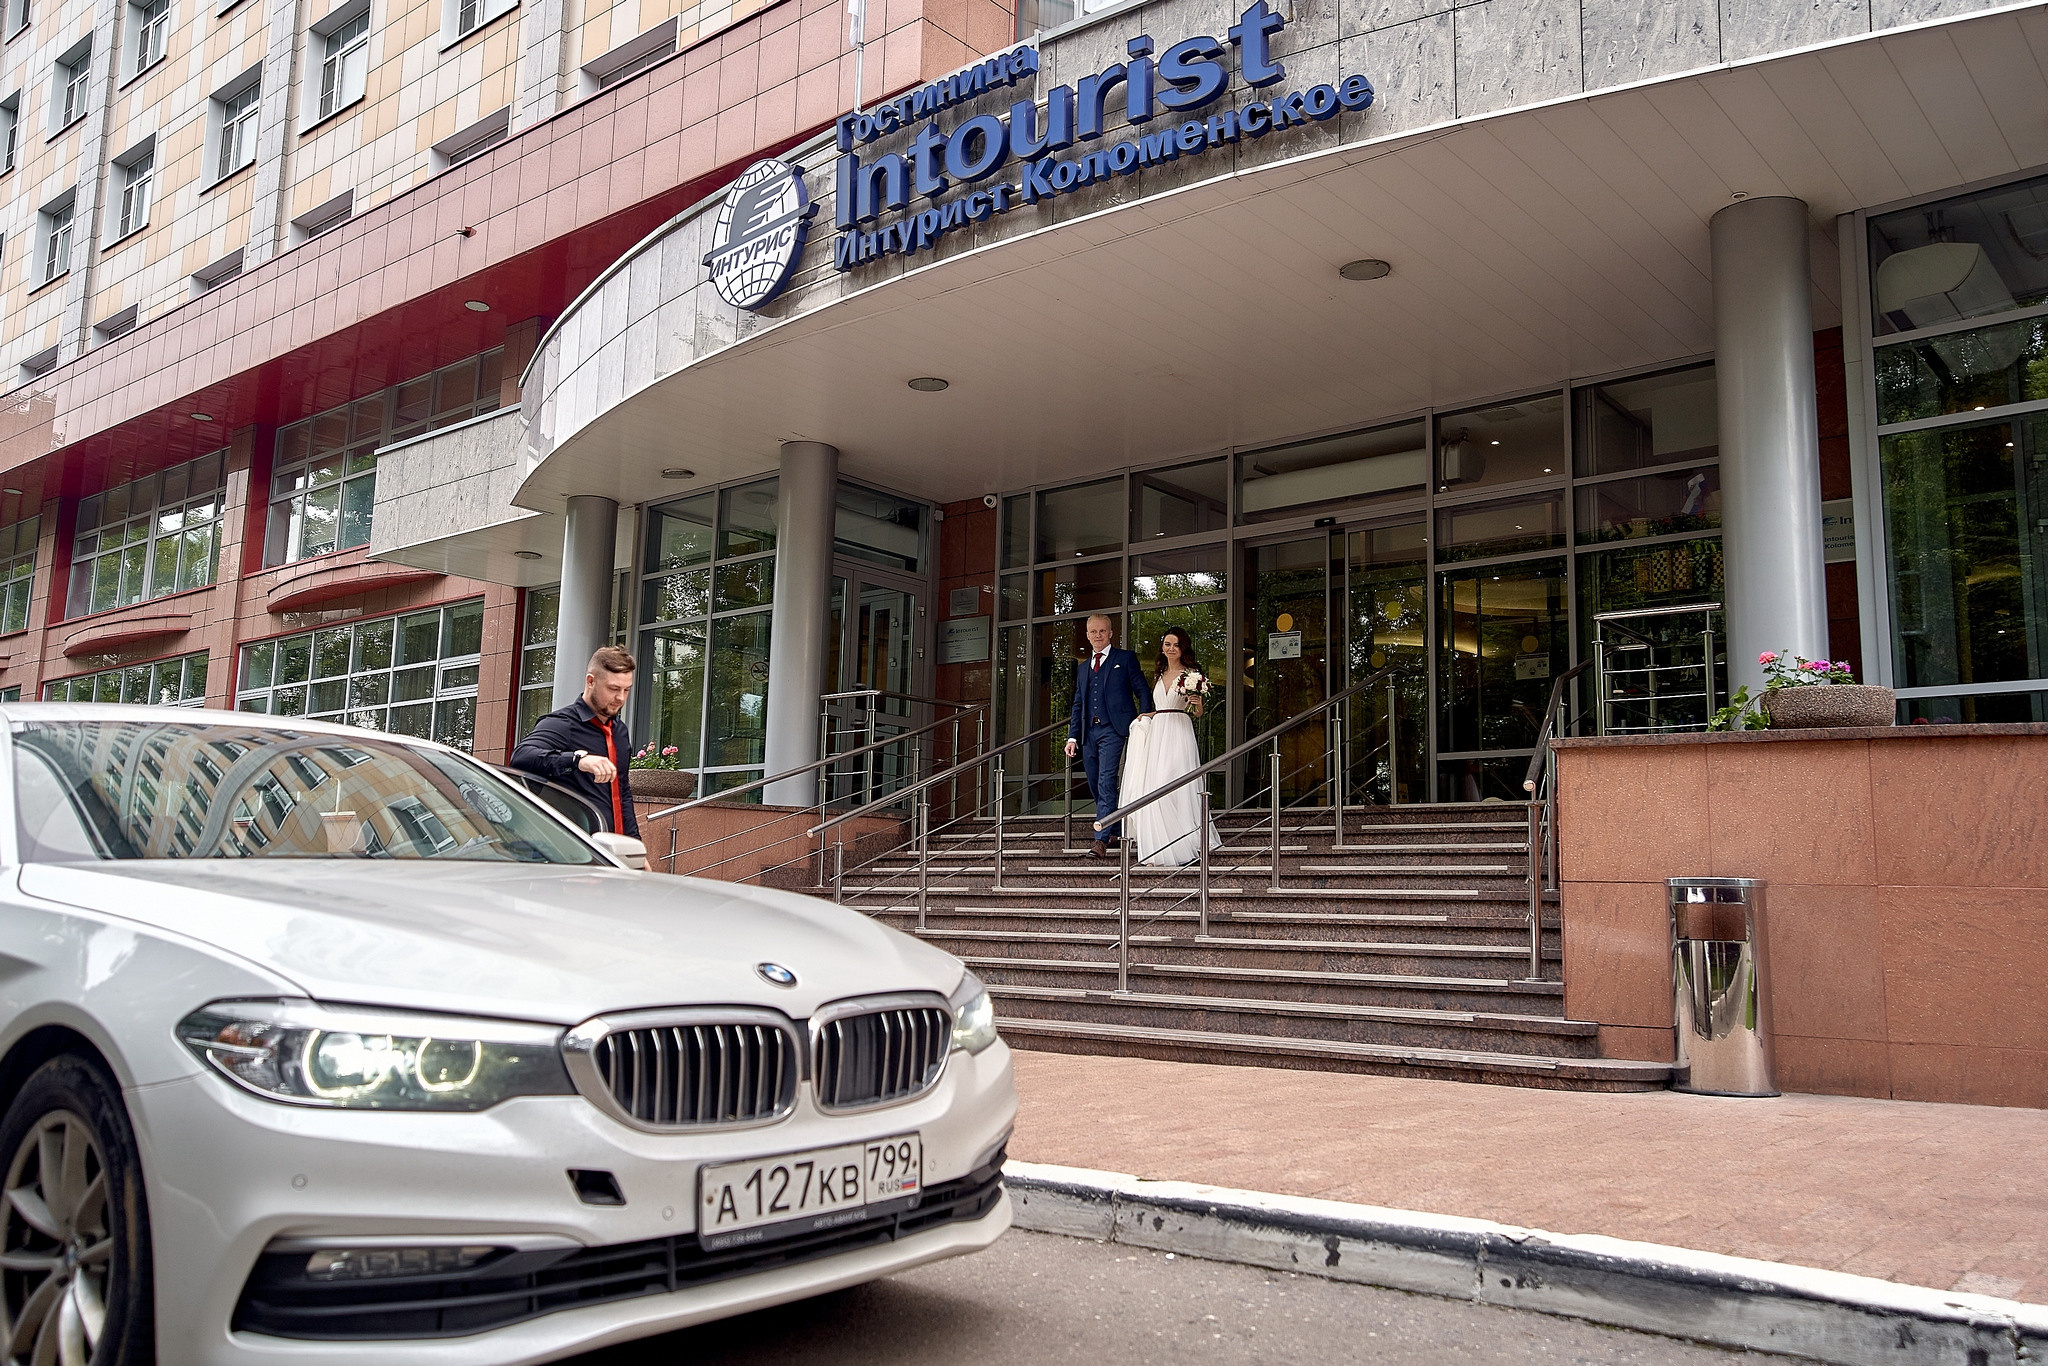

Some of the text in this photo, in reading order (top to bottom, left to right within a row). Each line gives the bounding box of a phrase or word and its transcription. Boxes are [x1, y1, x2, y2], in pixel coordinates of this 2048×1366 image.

[835, 44, 1038, 153] Гостиница
[835, 0, 1286, 231] Intourist
[834, 74, 1374, 273] Интурист Коломенское
[709, 219, 804, 281] ИНТУРИСТ
[869, 1141, 911, 1181] 799
[878, 1179, 900, 1194] RUS
